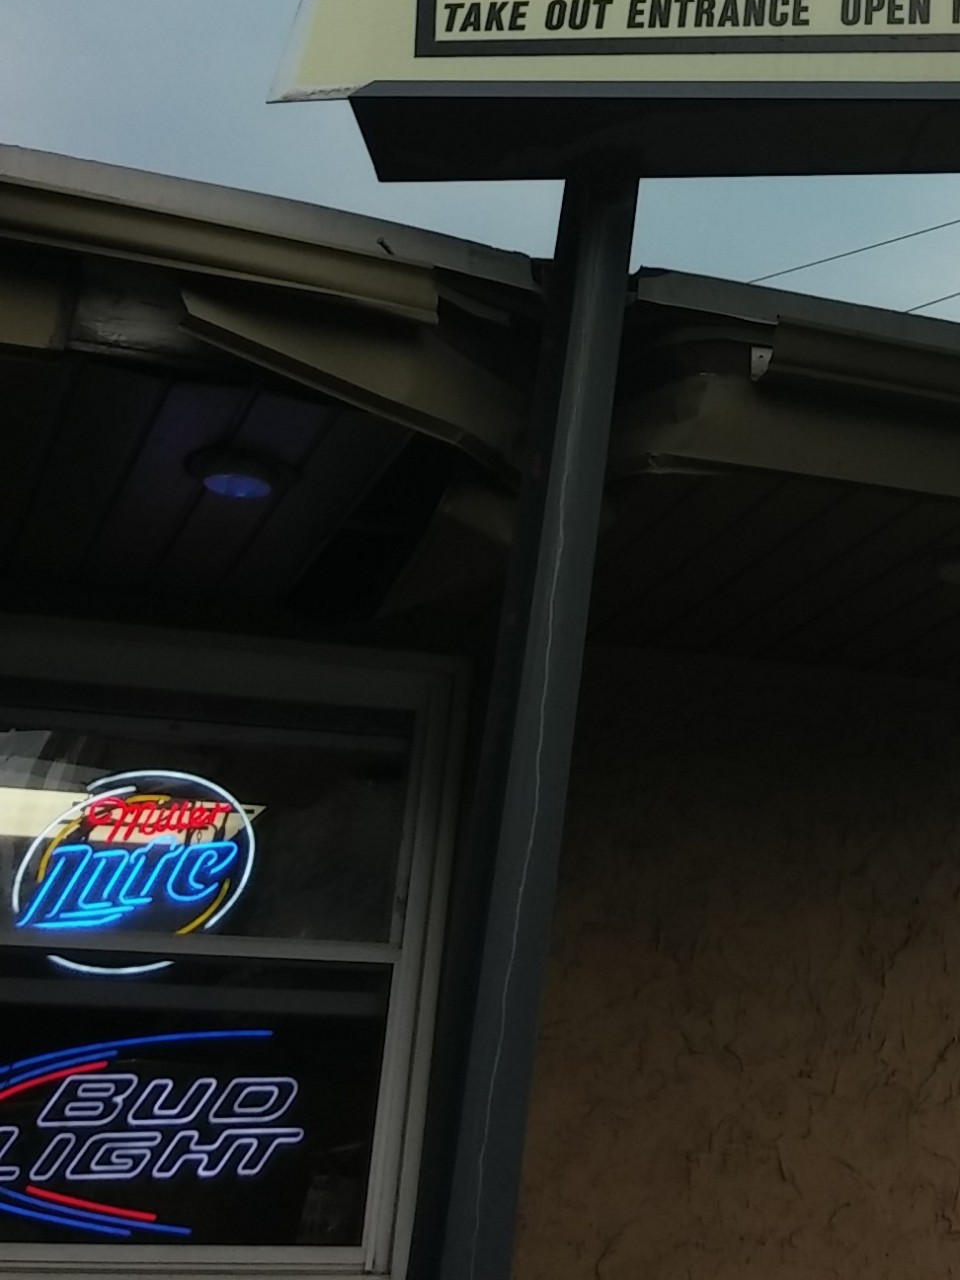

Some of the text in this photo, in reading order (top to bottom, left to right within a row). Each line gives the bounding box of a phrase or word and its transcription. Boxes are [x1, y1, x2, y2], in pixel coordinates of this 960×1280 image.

[443, 1, 530, 33] TAKE
[544, 0, 614, 31] OUT
[87, 796, 232, 844] Miller
[36, 1073, 299, 1127] BUD
